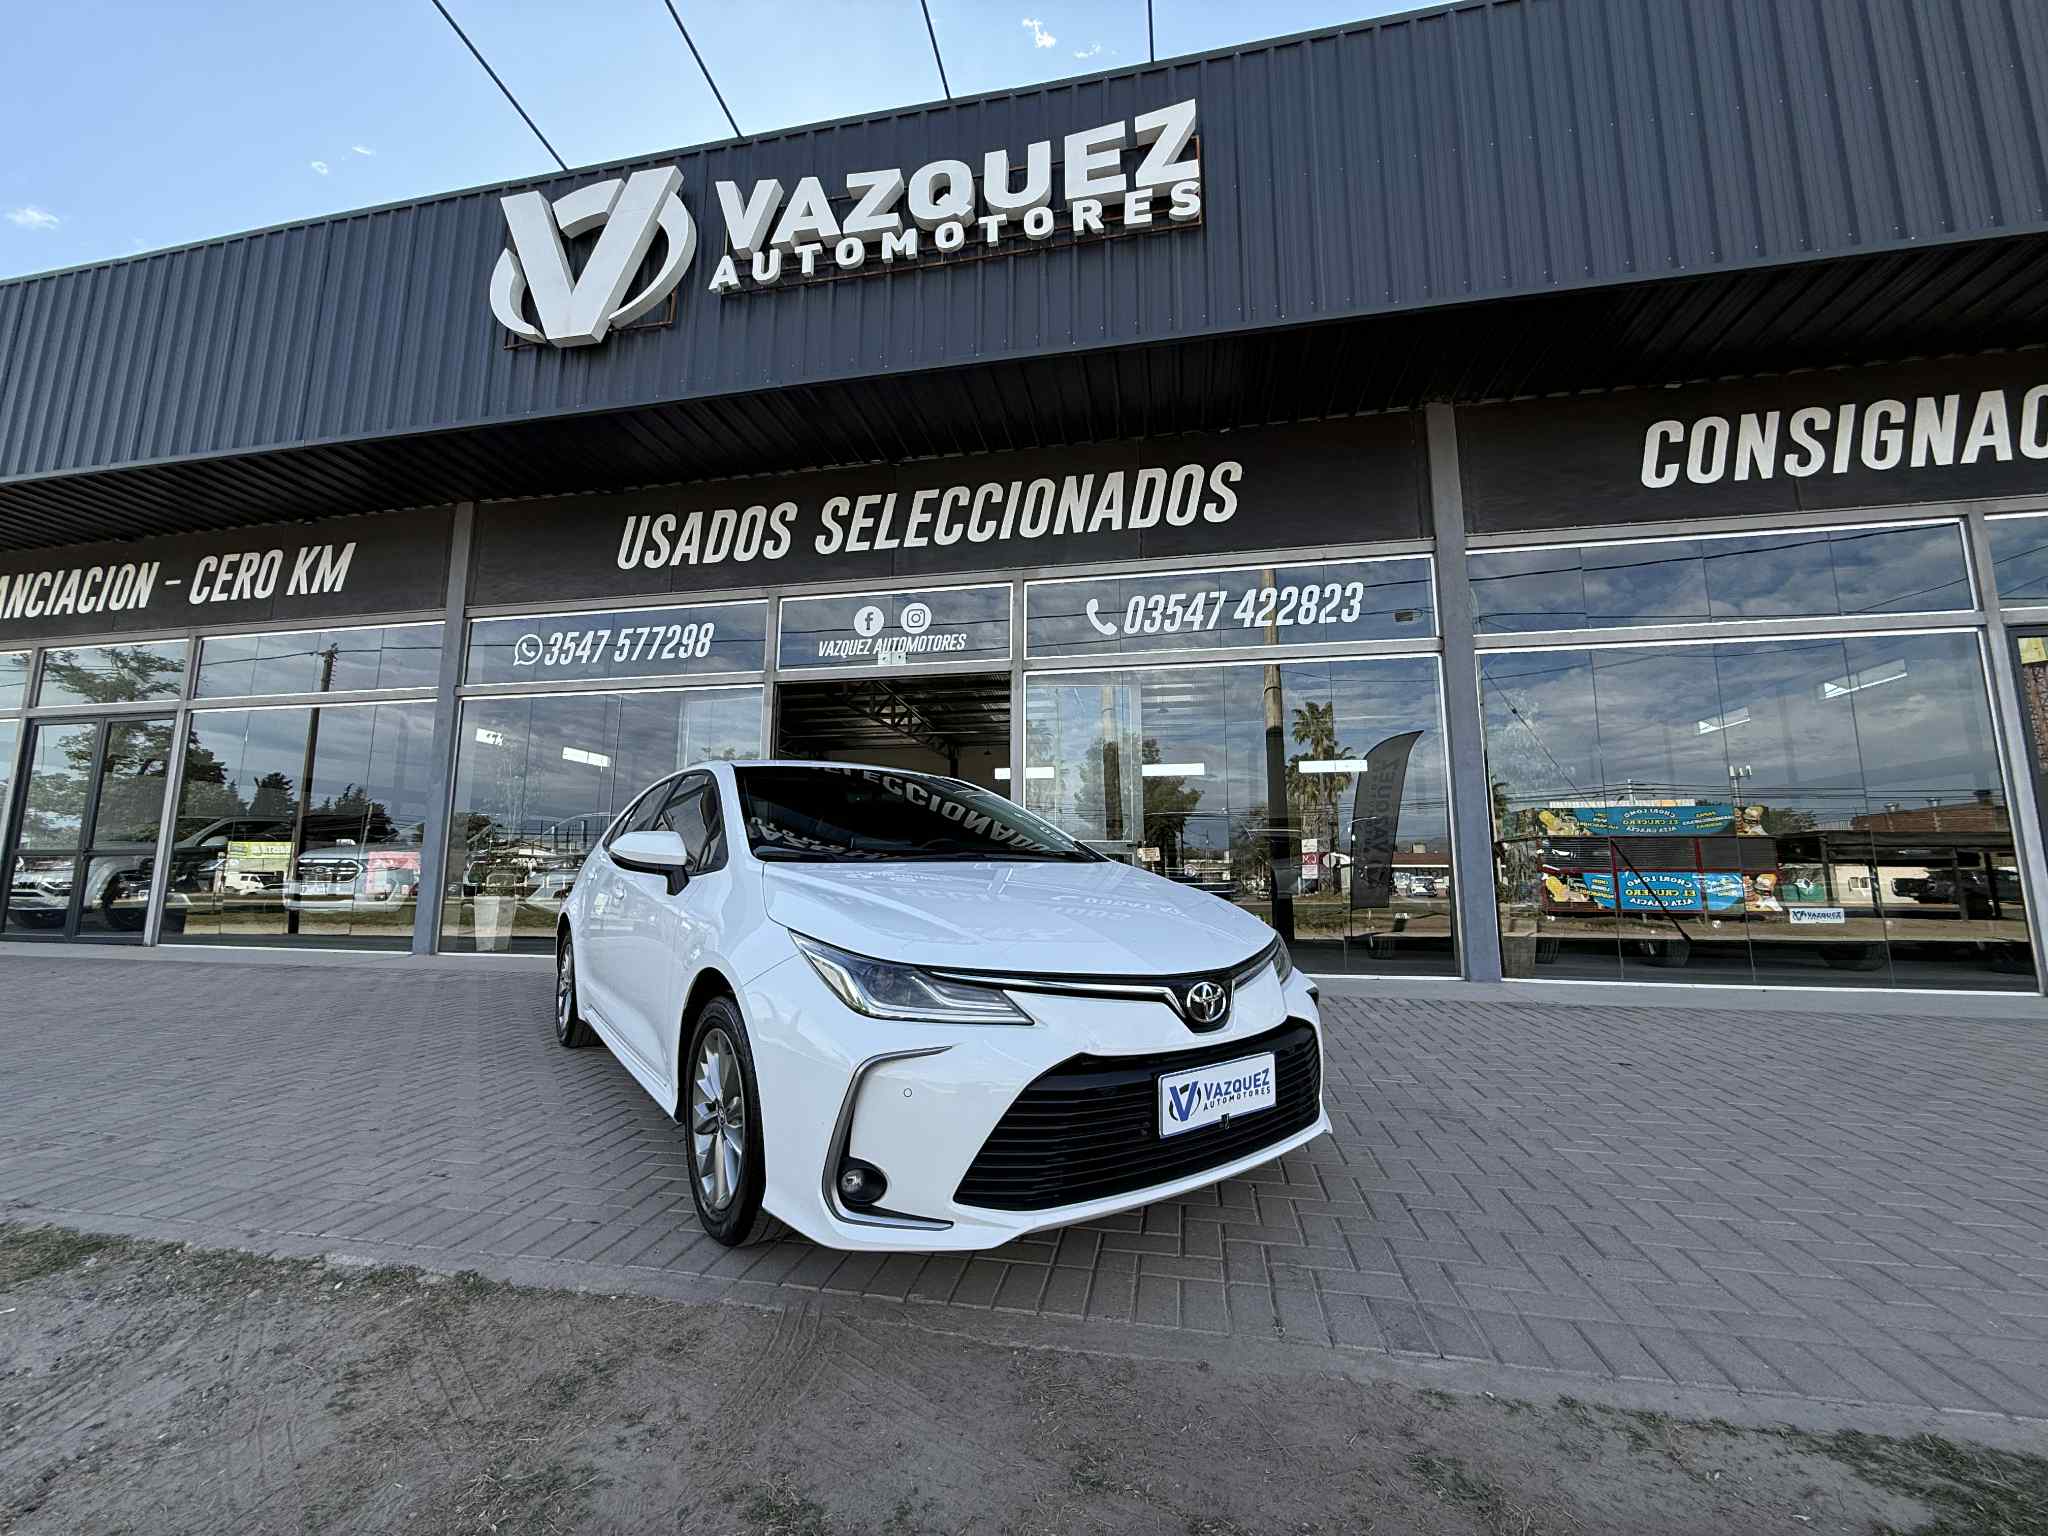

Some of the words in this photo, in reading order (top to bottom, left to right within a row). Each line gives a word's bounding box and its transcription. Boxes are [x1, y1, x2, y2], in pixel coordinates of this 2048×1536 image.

[715, 99, 1200, 259] VAZQUEZ
[708, 180, 1201, 293] AUTOMOTORES
[1641, 384, 2048, 488] CONSIGNAC
[617, 502, 798, 570] USADOS
[814, 461, 1242, 554] SELECCIONADOS
[189, 549, 283, 605] CERO
[286, 542, 356, 596] KM
[1123, 591, 1228, 634] 03547
[1233, 581, 1364, 628] 422823
[544, 631, 611, 666] 3547
[613, 622, 715, 663] 577298
[818, 638, 873, 658] VAZQUEZ
[873, 633, 967, 655] AUTOMOTORES
[1203, 1087, 1271, 1111] AUTOMOTORES
[1204, 1068, 1270, 1100] VAZQUEZ
